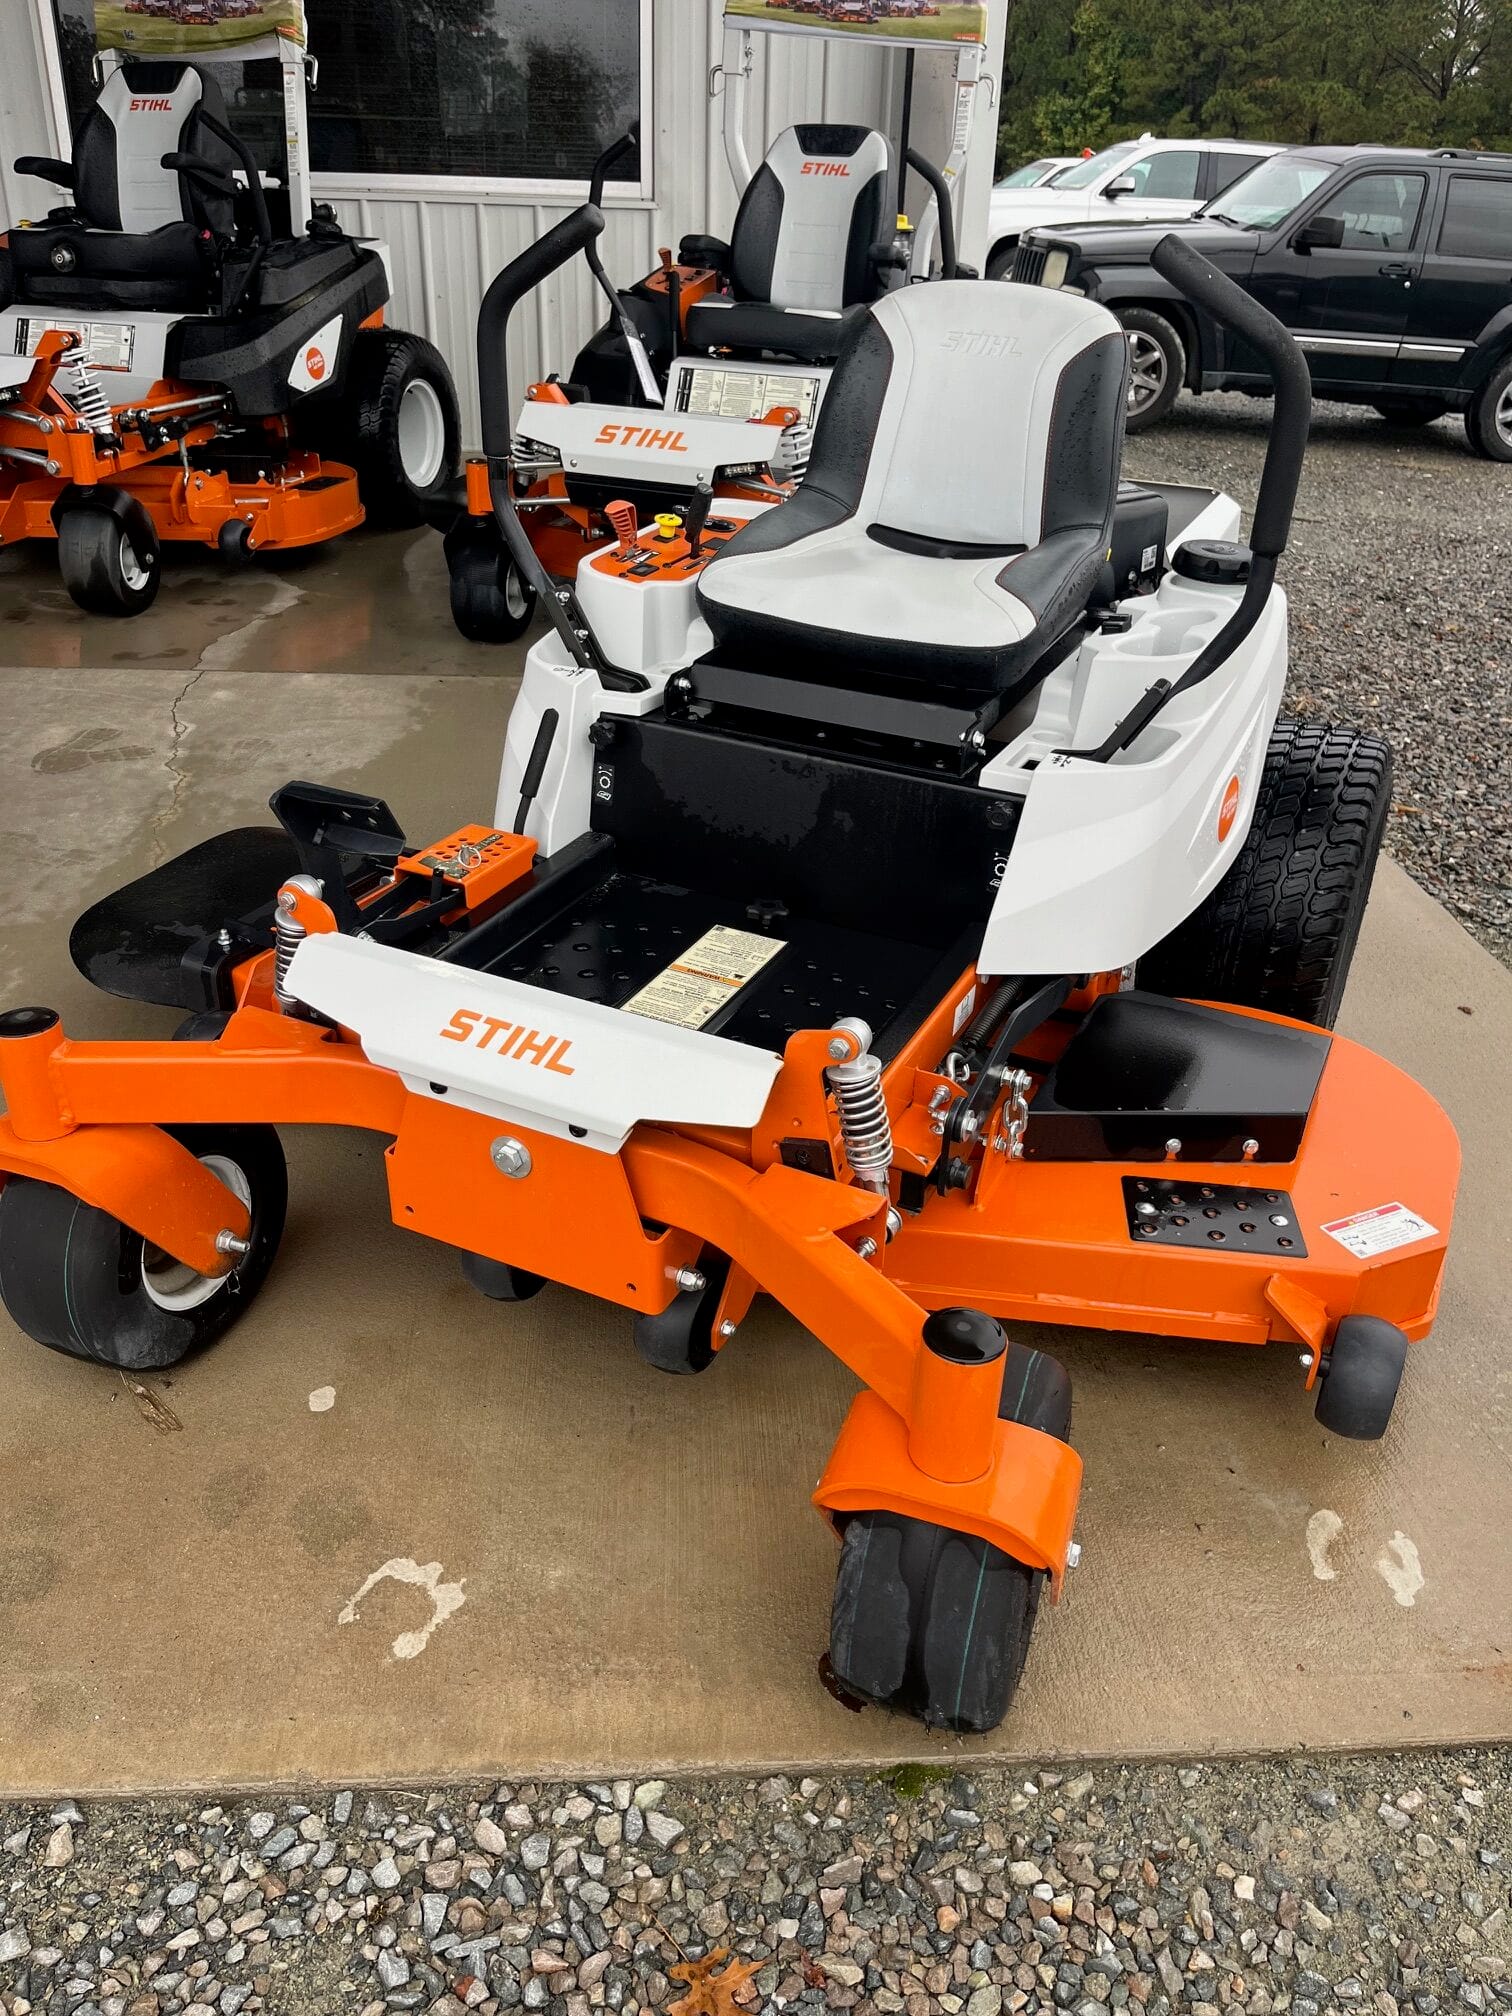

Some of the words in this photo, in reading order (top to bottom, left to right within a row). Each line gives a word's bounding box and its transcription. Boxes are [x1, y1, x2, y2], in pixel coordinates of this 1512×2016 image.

[129, 98, 173, 112] STIHL
[800, 162, 851, 177] STIHL
[938, 330, 1024, 359] STIHL
[594, 424, 689, 452] STIHL
[439, 1008, 576, 1076] STIHL
